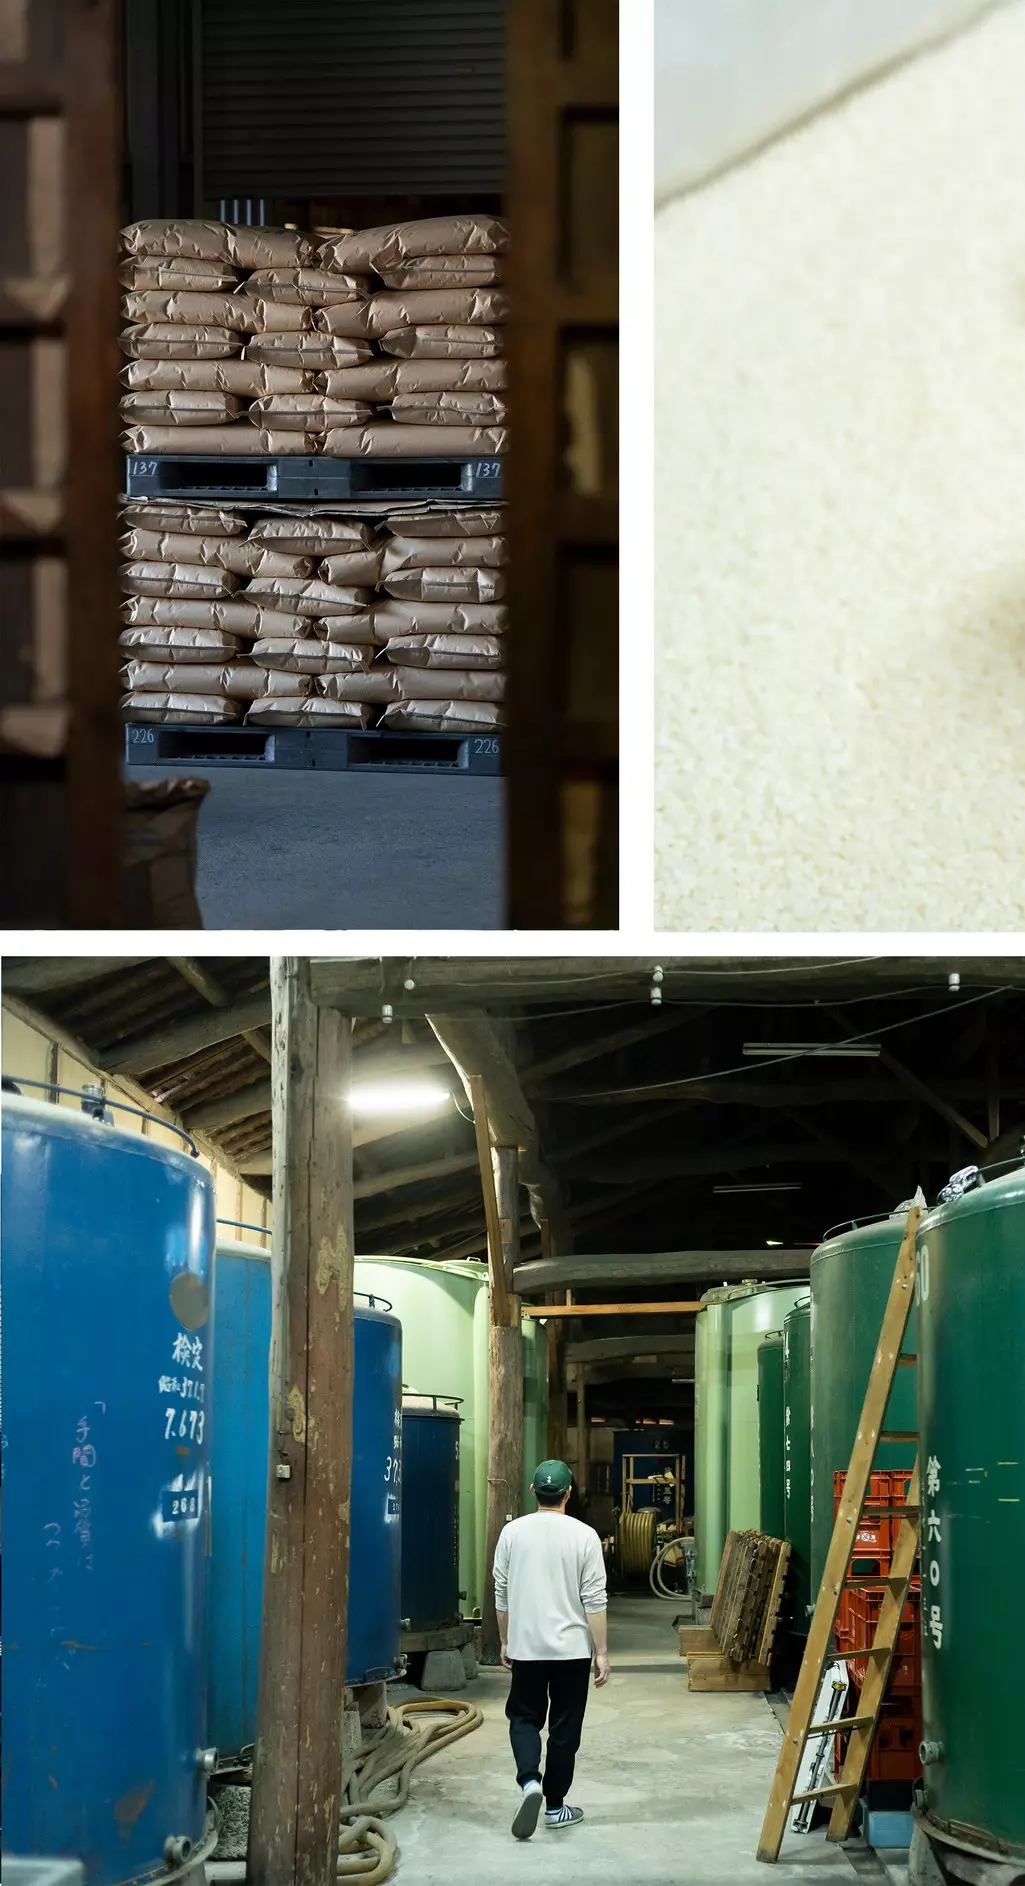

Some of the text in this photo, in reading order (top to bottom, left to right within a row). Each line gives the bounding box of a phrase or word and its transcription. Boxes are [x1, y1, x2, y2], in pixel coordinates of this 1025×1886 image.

[133, 461, 158, 476] 137
[475, 462, 501, 478] 137
[131, 728, 155, 744] 226
[474, 738, 499, 754] 226
[172, 1332, 204, 1371] 検定
[164, 1407, 205, 1445] 7.673
